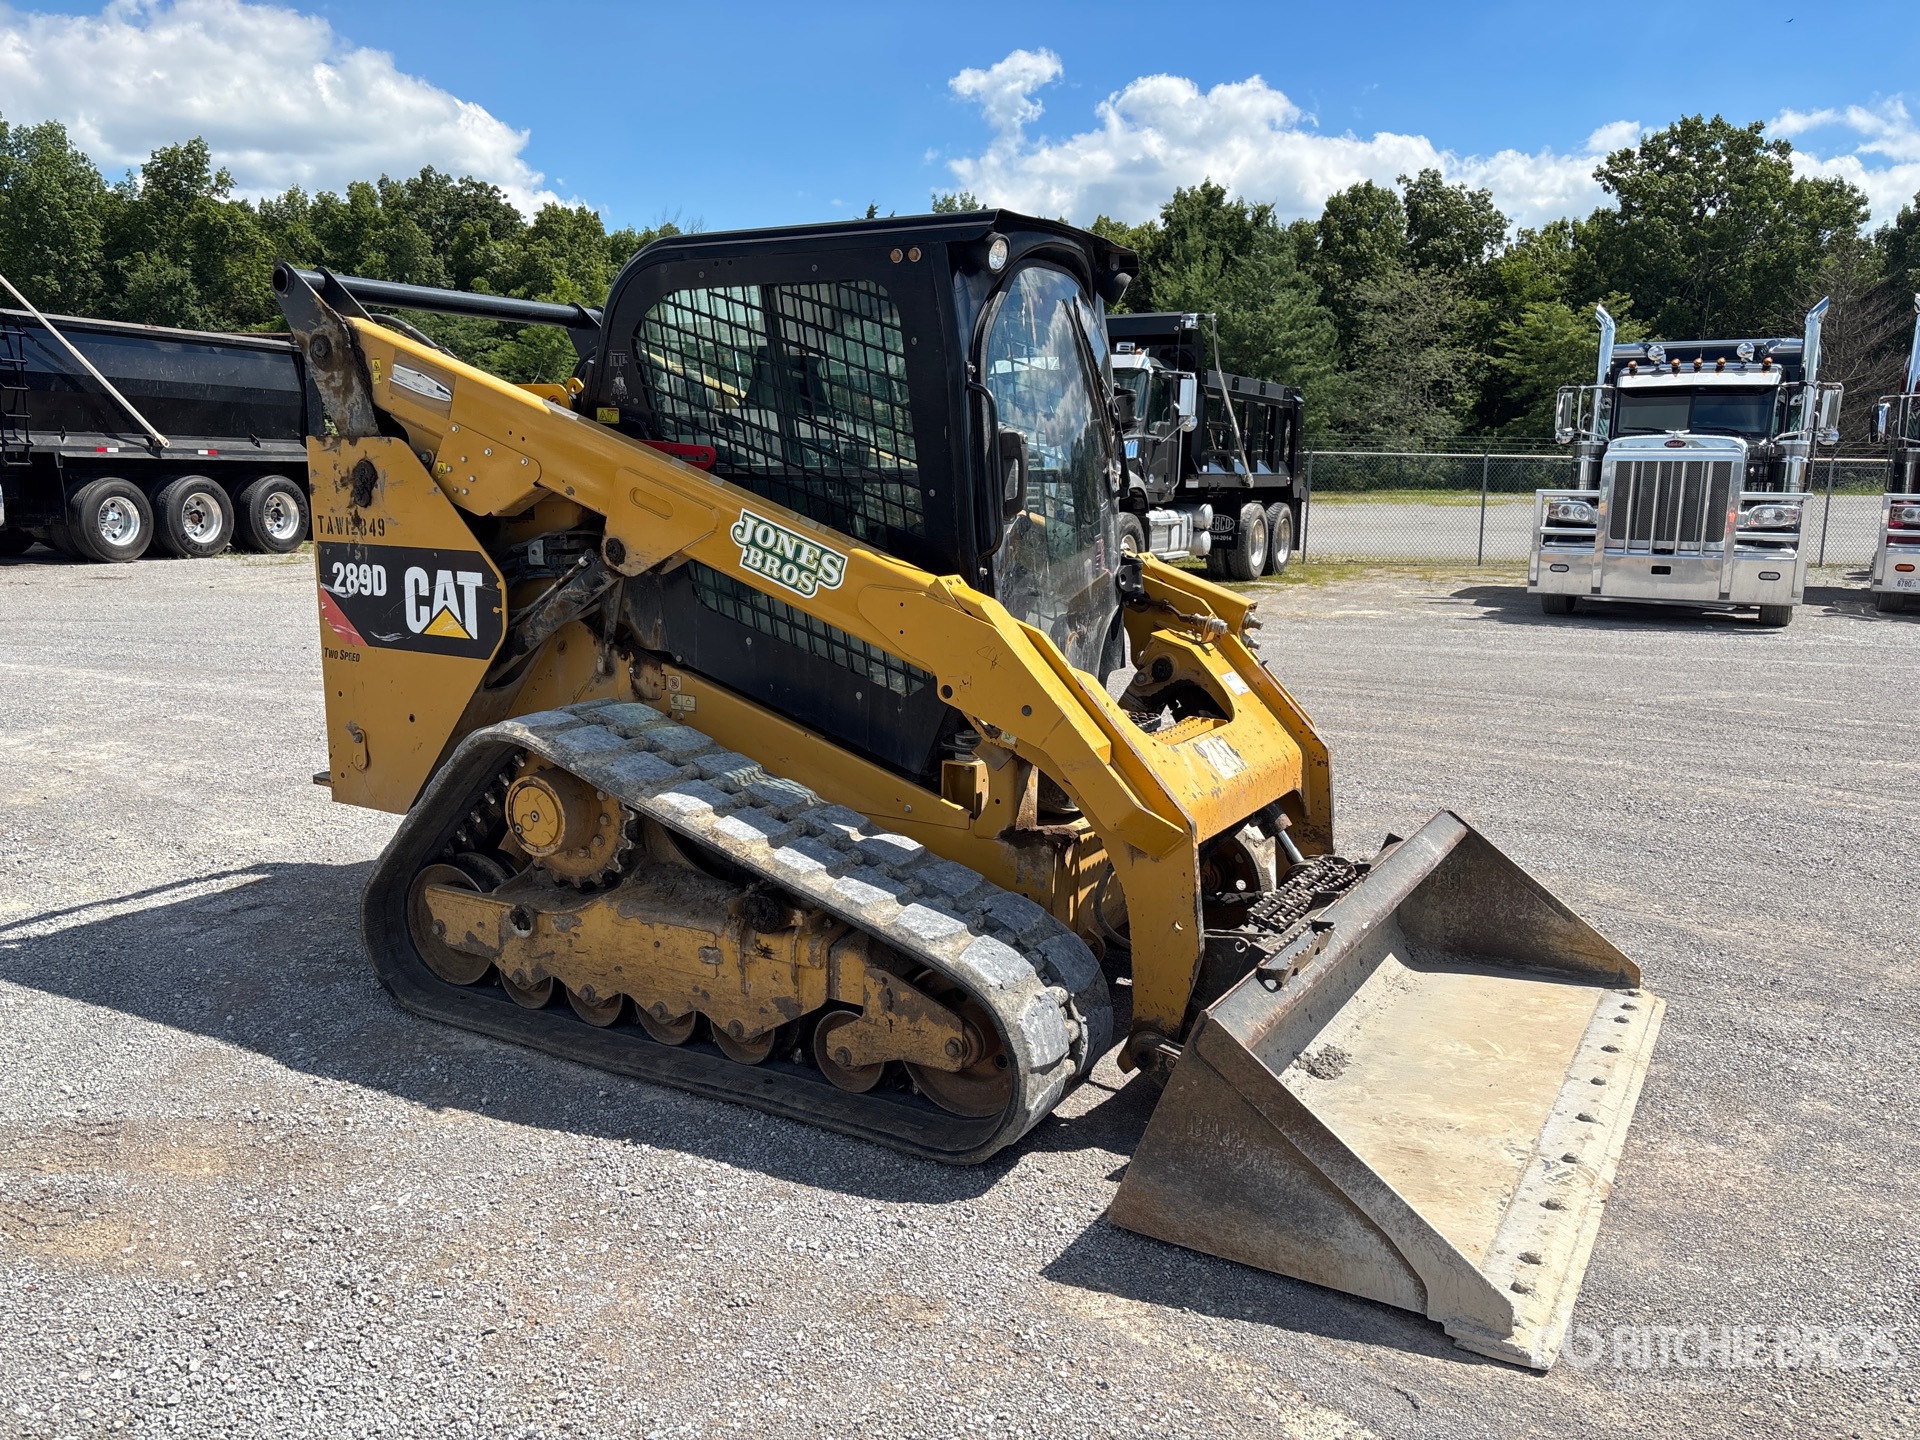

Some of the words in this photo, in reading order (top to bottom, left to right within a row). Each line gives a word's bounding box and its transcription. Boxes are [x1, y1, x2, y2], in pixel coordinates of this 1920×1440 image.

[332, 562, 387, 597] 289D
[734, 514, 843, 585] JONES
[743, 544, 816, 594] BROS
[404, 566, 482, 640] CAT
